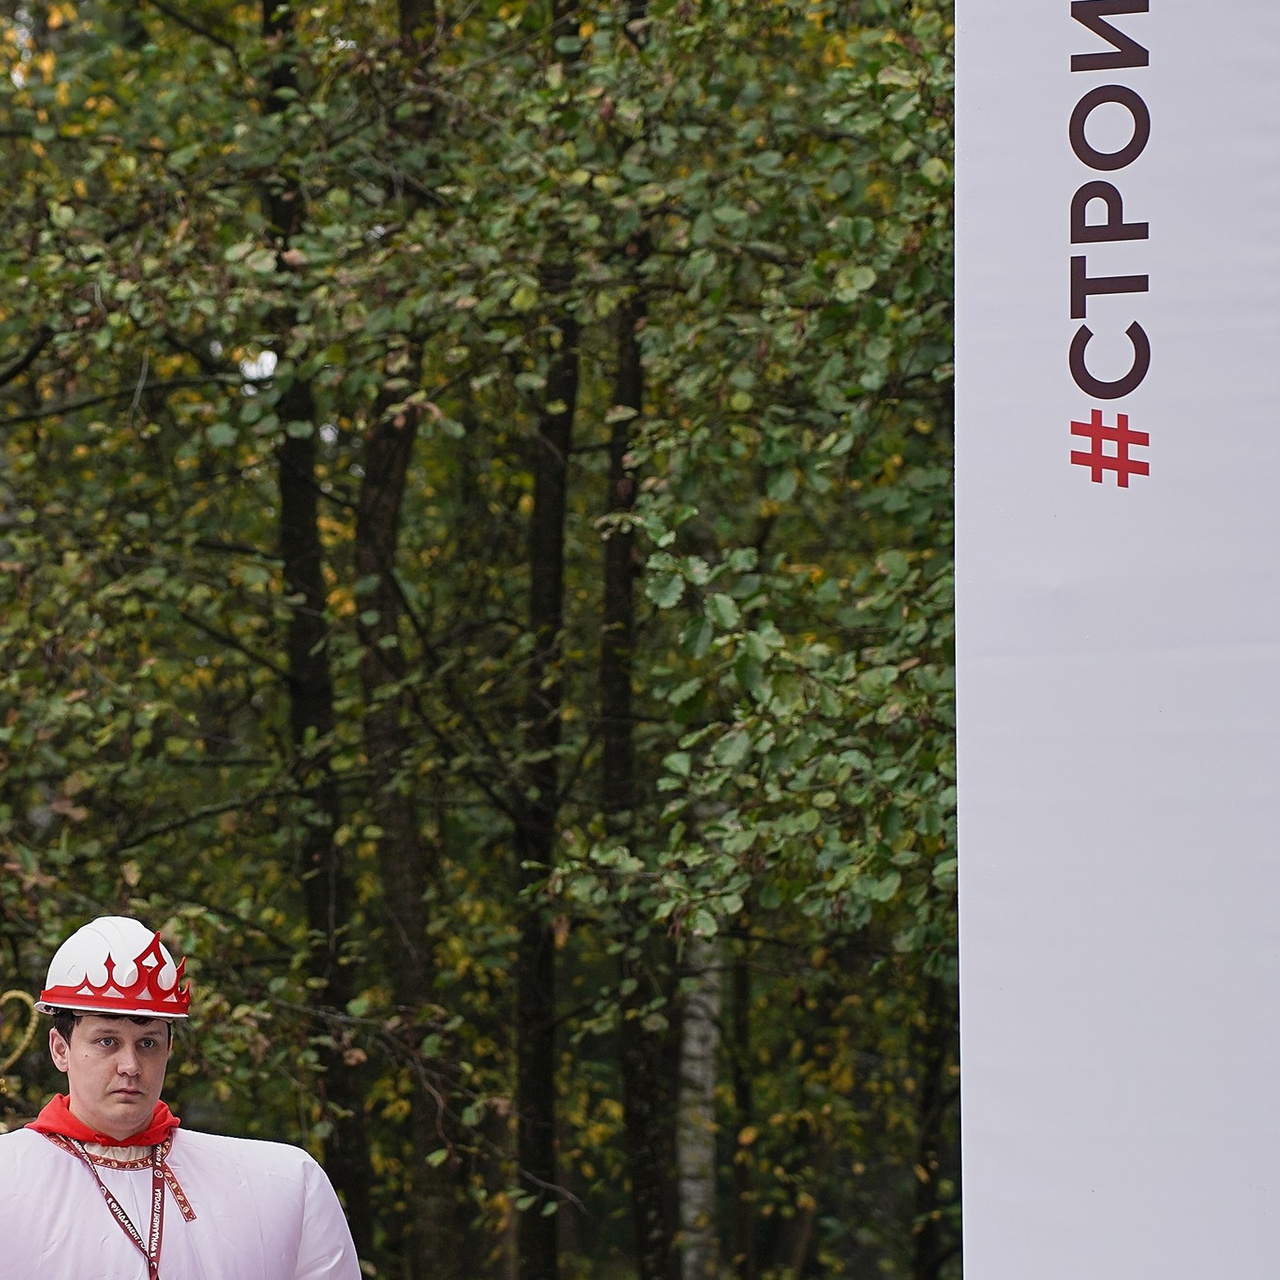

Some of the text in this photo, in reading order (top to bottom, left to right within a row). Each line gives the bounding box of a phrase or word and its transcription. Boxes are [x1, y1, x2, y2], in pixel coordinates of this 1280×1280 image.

[154, 1188, 162, 1213] ГОРОДА
[111, 1202, 141, 1240] ФУНДАМЕНТ
[151, 1213, 160, 1252] ФУНДАМЕНТ
